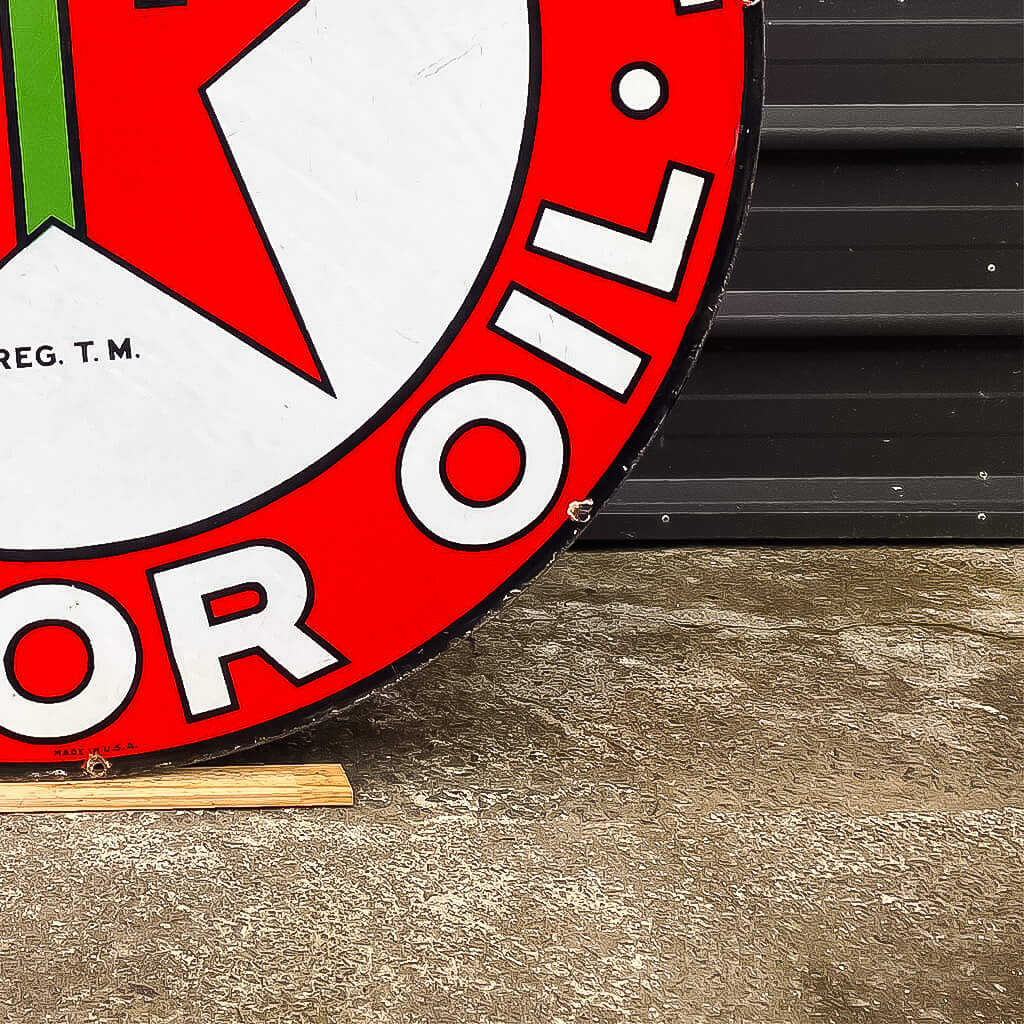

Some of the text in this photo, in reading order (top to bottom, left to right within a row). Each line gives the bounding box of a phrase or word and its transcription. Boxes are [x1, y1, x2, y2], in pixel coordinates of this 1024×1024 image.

[74, 340, 99, 363] T.
[107, 337, 140, 361] M.
[395, 160, 715, 552] OIL
[54, 748, 83, 757] MADE
[104, 742, 138, 754] U.S.A.
